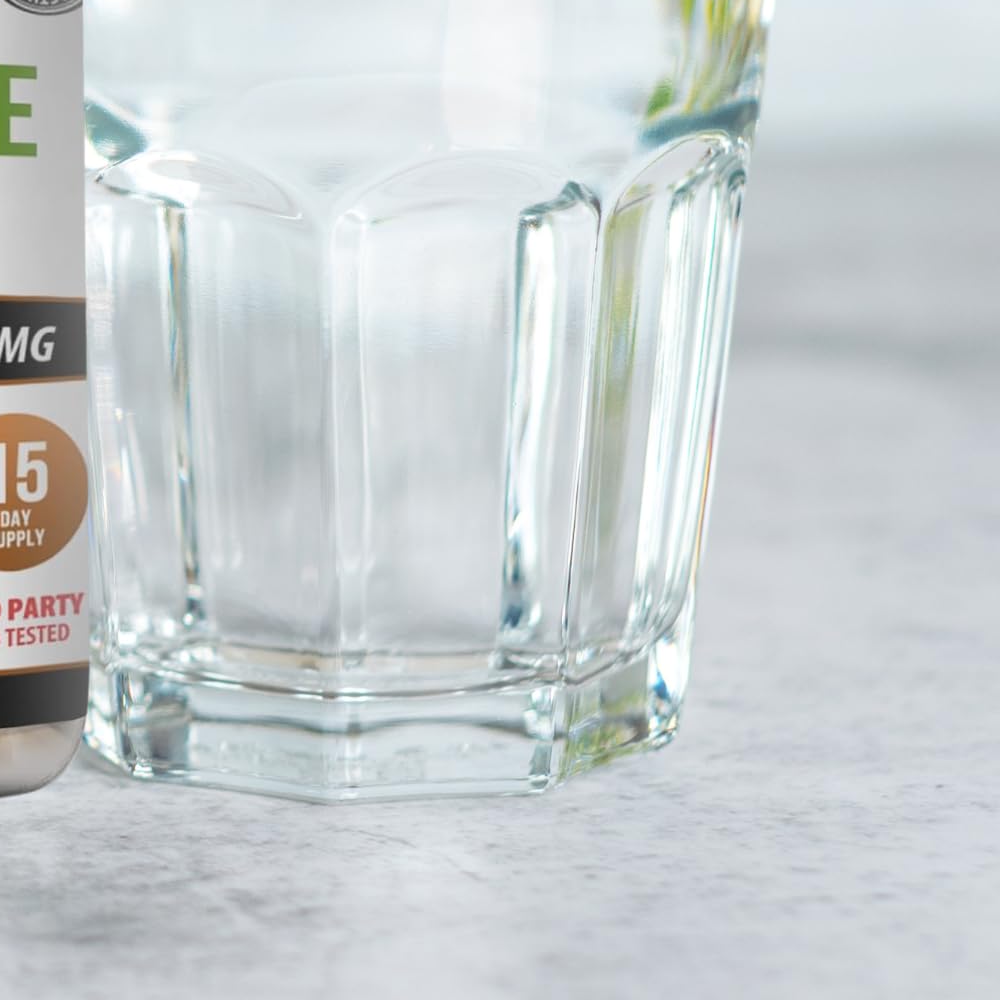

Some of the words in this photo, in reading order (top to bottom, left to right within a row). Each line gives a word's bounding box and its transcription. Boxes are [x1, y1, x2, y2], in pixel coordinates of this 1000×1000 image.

[0, 509, 31, 528] DAY
[7, 592, 84, 621] PARTY
[5, 623, 70, 647] TESTED
